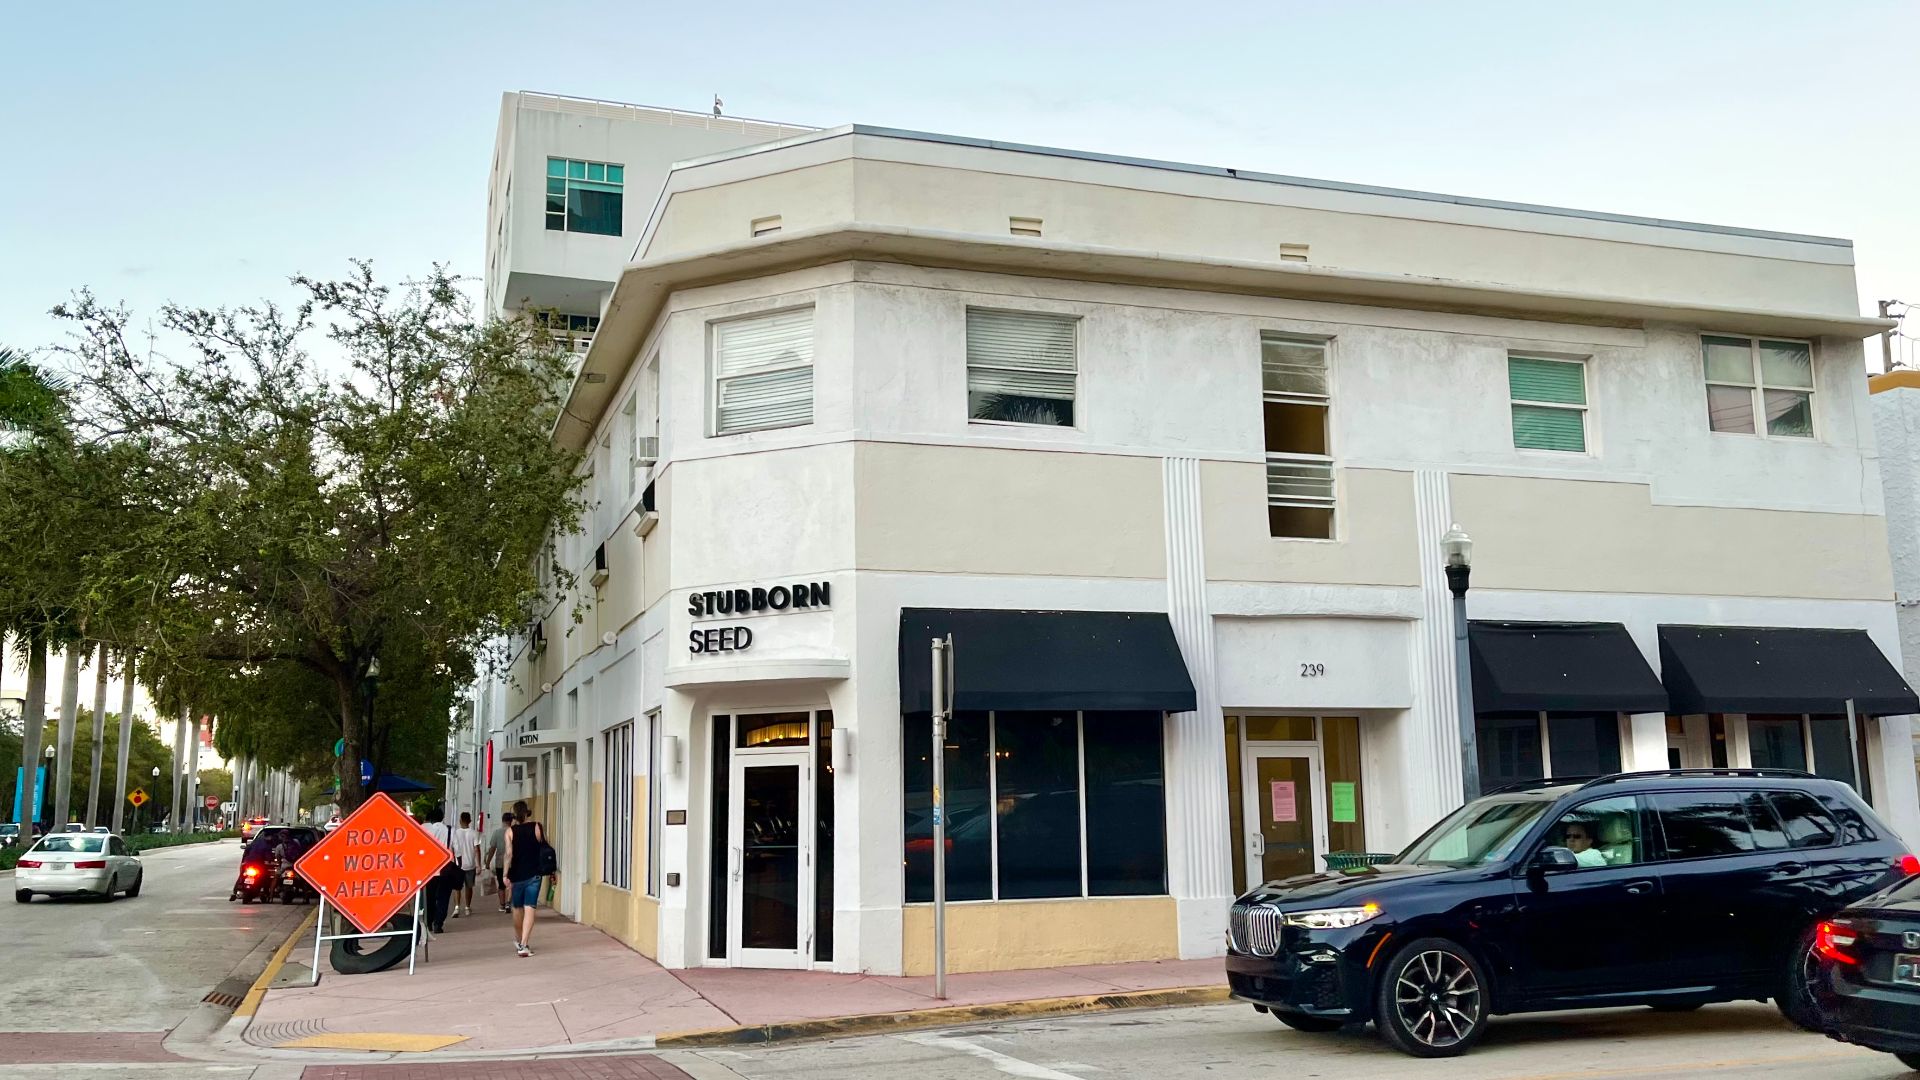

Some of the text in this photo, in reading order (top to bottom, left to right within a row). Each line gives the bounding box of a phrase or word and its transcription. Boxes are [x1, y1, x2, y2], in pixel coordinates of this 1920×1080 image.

[688, 581, 831, 616] STUBBORN
[689, 626, 753, 653] SEED
[1301, 663, 1324, 677] 239
[346, 828, 406, 846] ROAD
[343, 852, 405, 872] WORK
[334, 878, 410, 898] AHEAD
